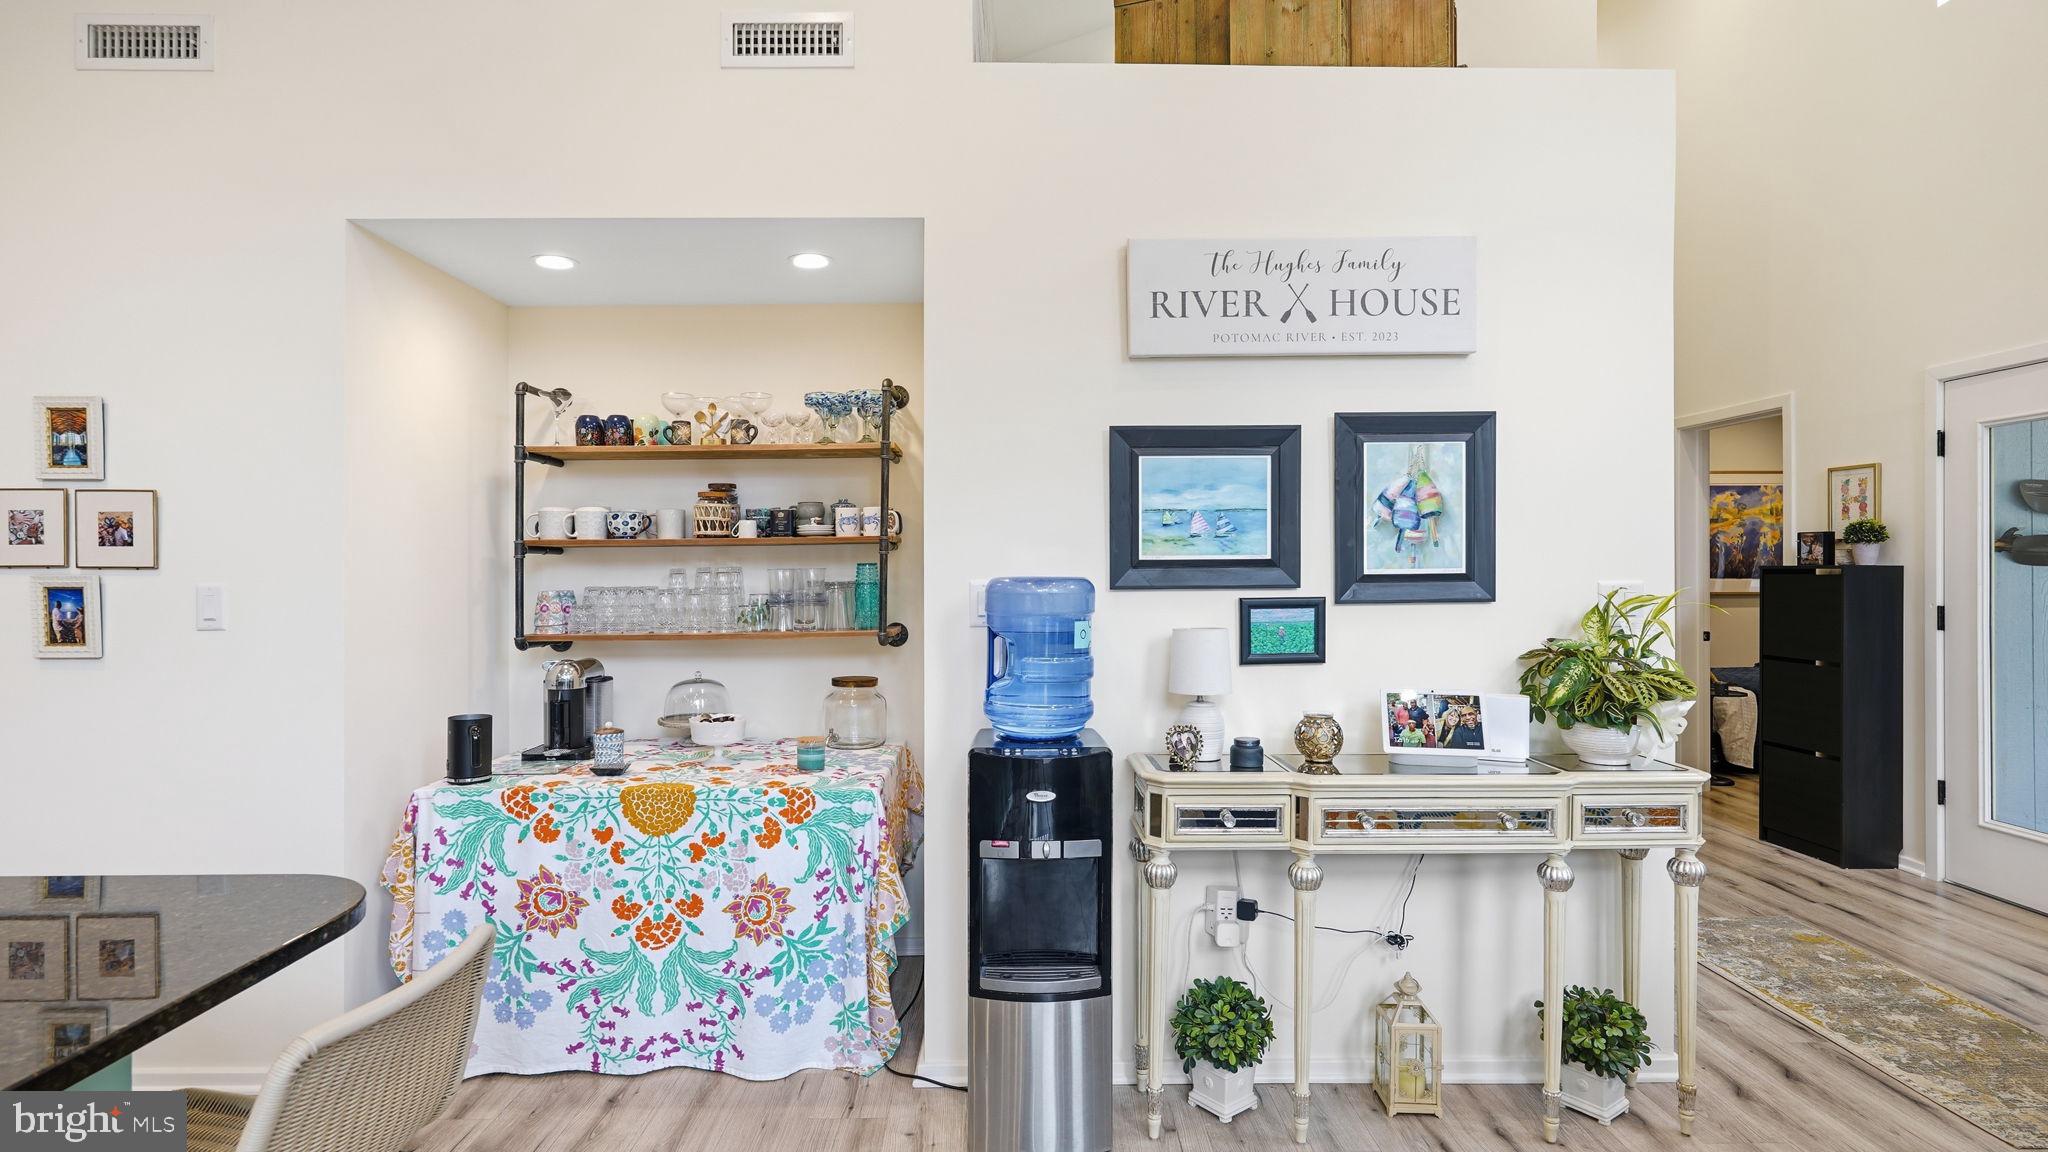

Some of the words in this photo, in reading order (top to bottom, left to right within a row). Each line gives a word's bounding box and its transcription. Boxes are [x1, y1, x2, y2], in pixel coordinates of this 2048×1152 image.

[1246, 248, 1325, 283] Hughes
[1331, 247, 1407, 283] Family
[1148, 289, 1270, 319] RIVER
[1328, 287, 1462, 318] HOUSE
[1212, 331, 1283, 344] POTOMAC
[1285, 331, 1328, 343] RIVER
[1340, 331, 1368, 342] EST.
[1371, 331, 1400, 343] 2023
